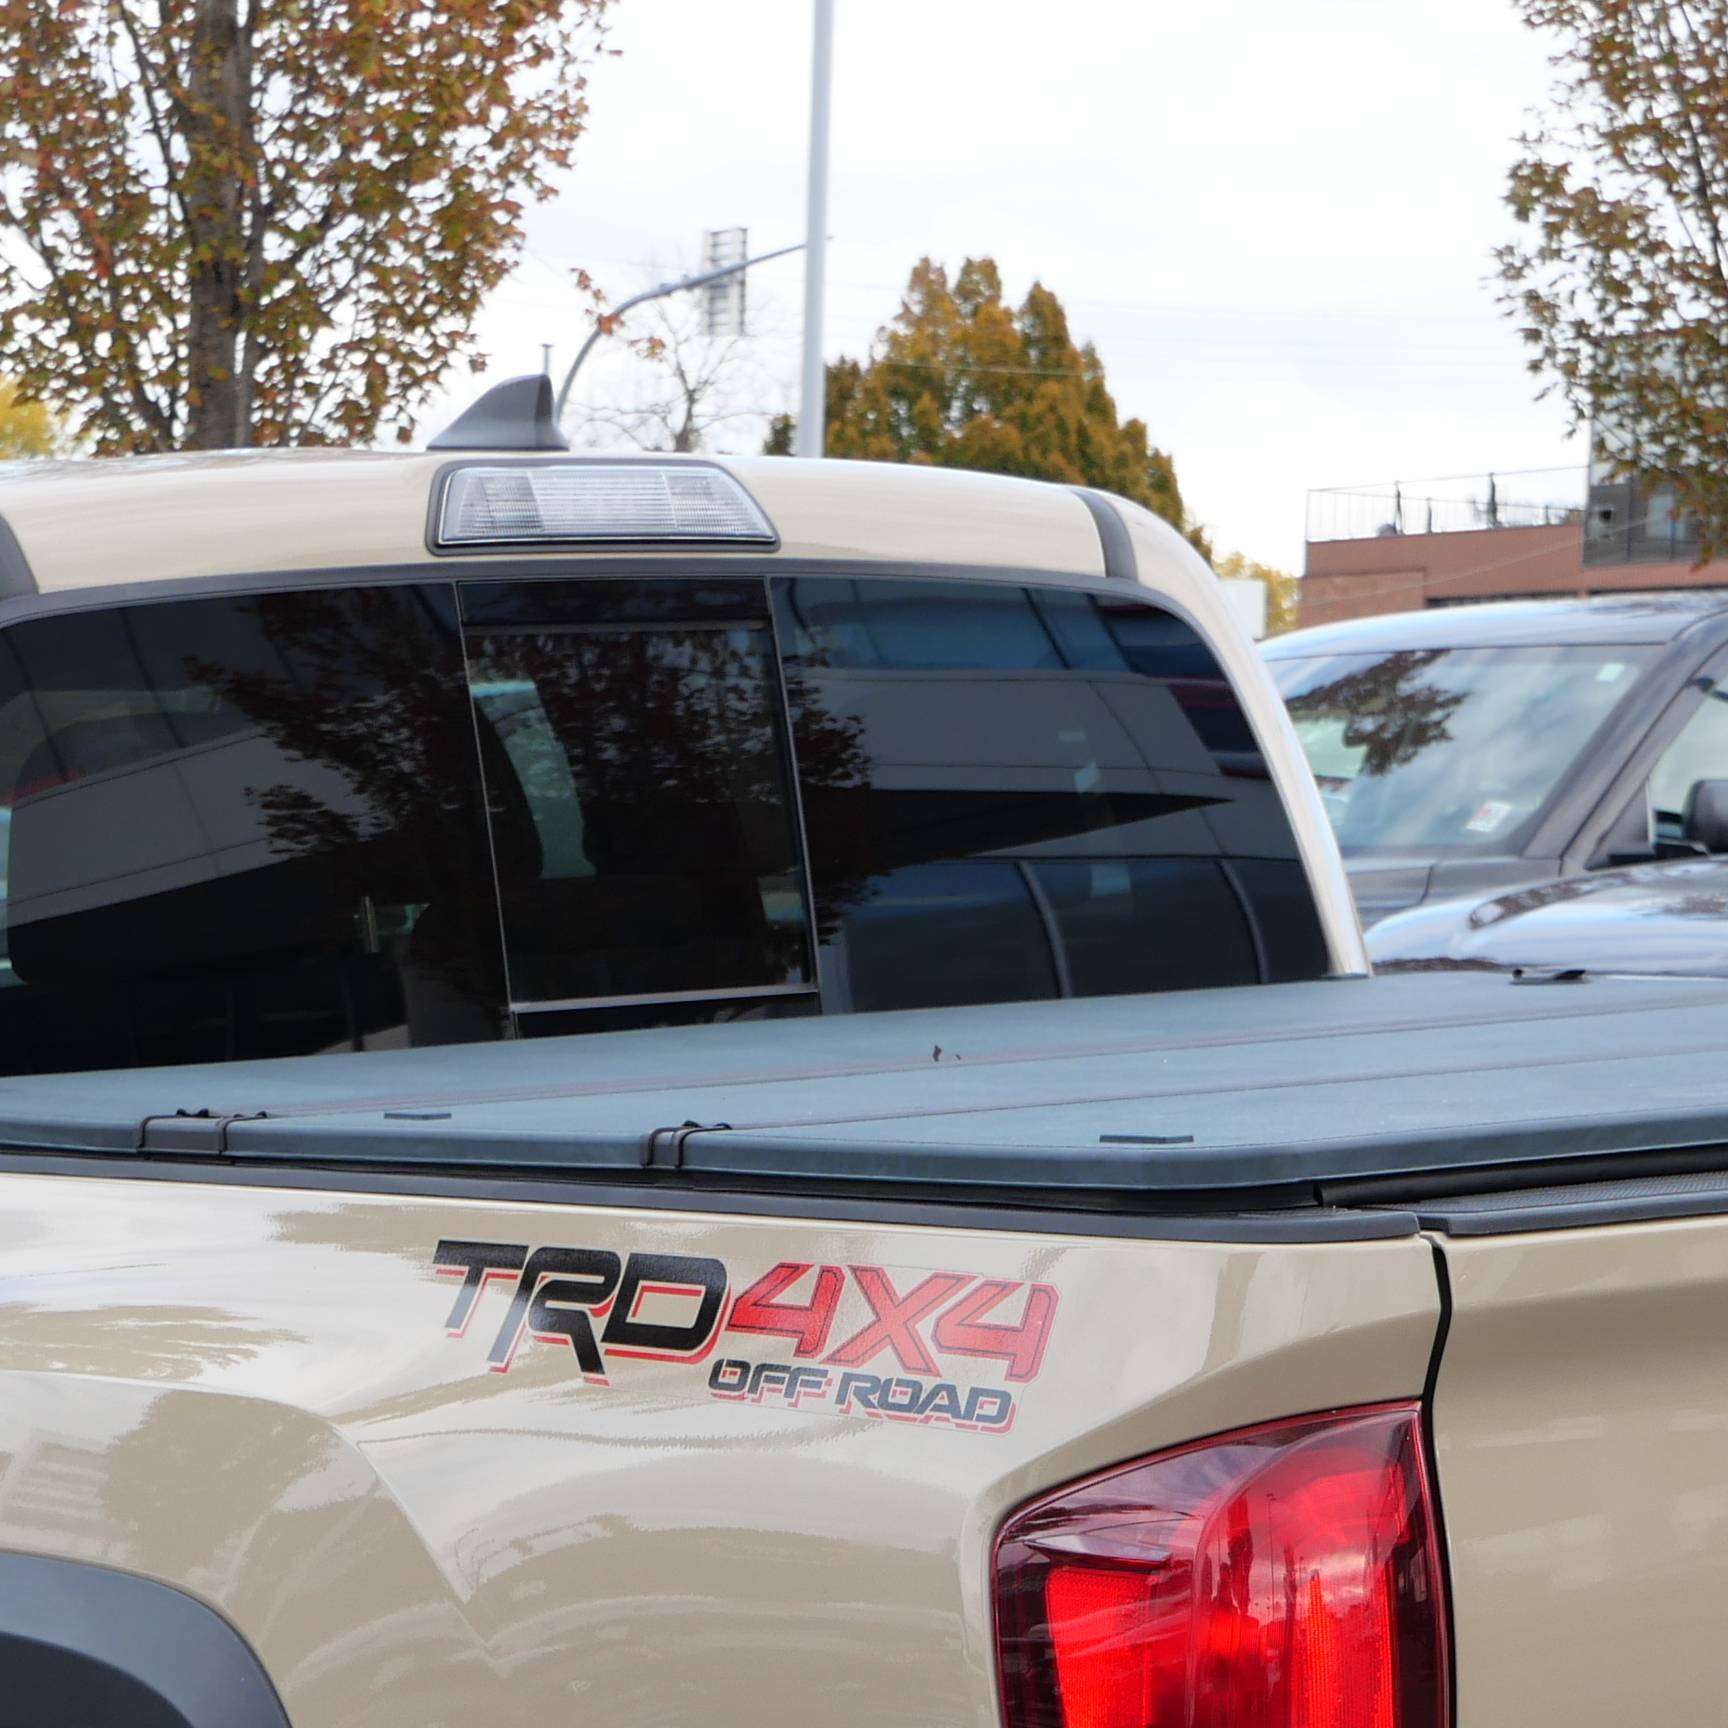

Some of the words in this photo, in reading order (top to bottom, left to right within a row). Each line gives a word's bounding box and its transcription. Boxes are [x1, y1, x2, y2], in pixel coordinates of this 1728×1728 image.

[433, 1239, 732, 1387] TRD
[727, 1262, 1059, 1382] 4X4
[708, 1358, 833, 1411] OFF
[835, 1376, 1016, 1434] ROAD
